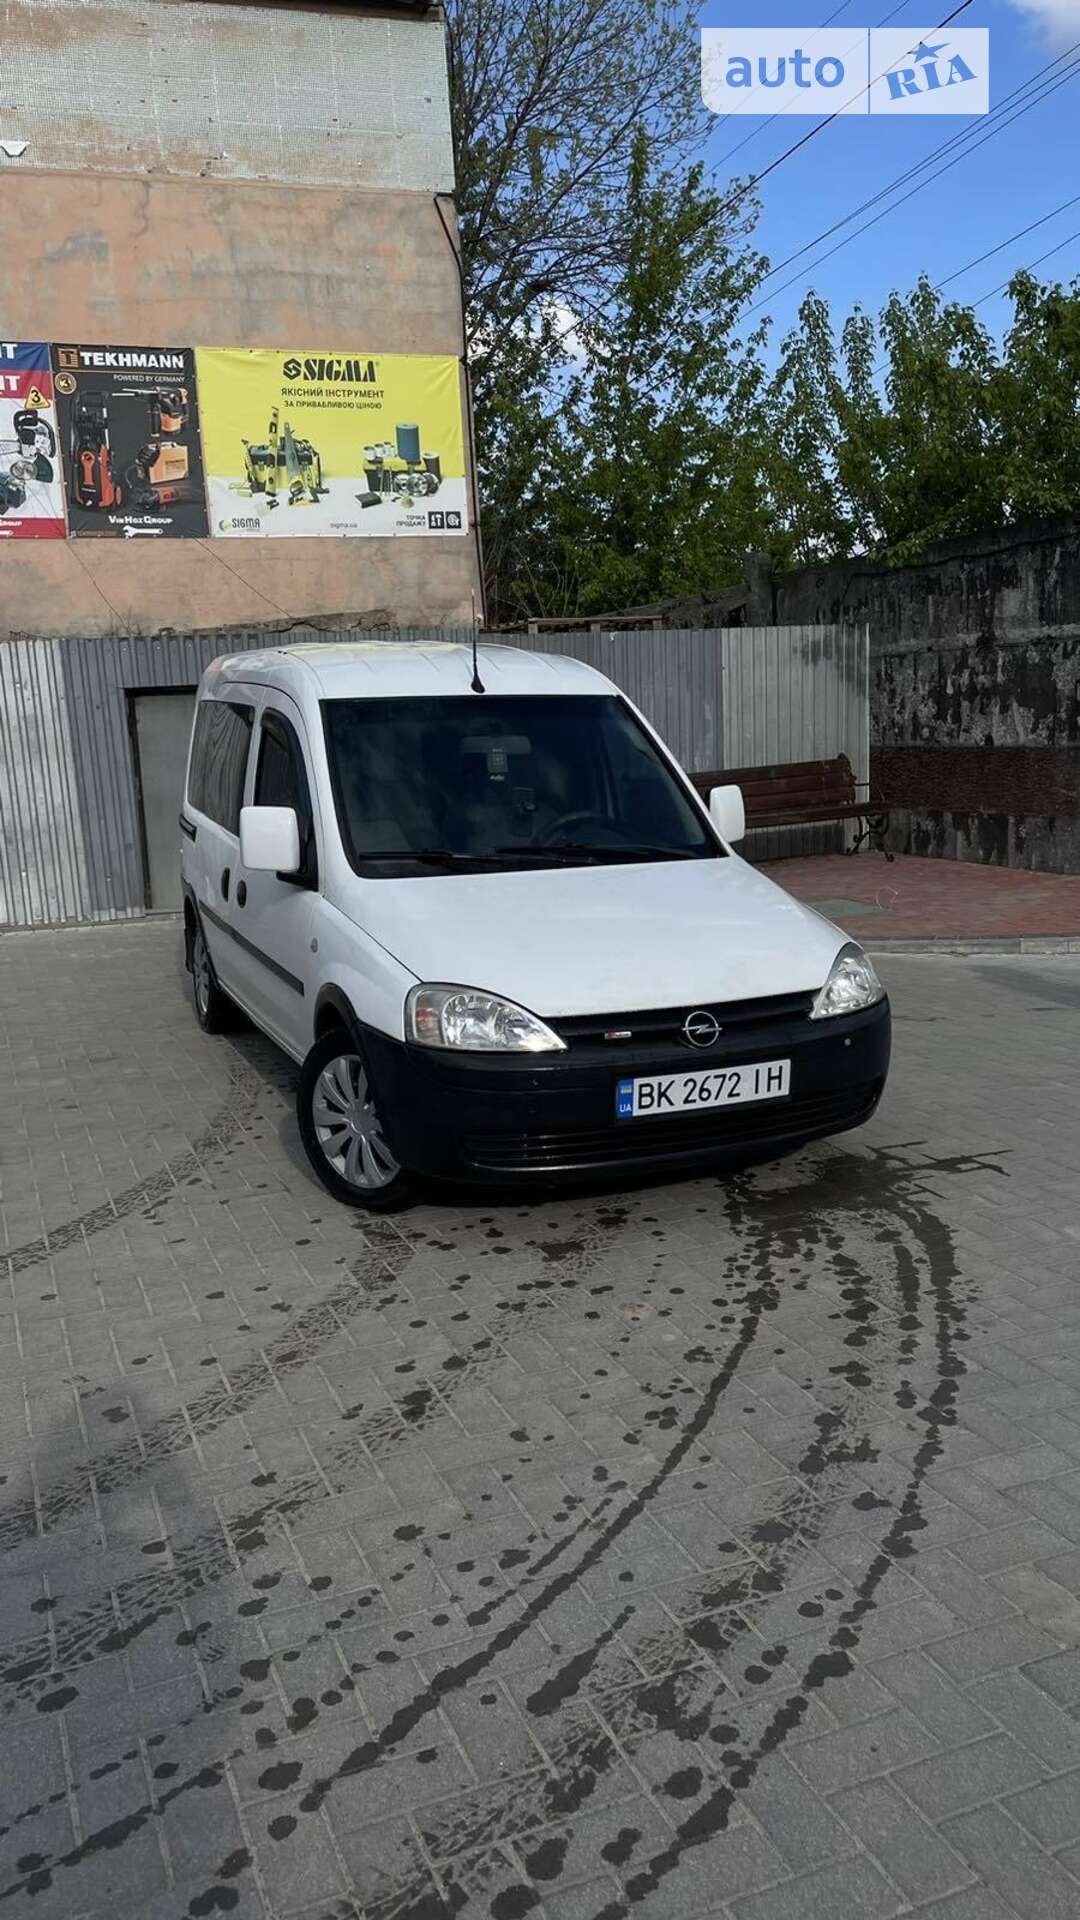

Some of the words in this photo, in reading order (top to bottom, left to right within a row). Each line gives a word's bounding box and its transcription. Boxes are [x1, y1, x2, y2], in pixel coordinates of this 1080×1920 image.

[80, 351, 184, 369] TEKHMANN
[303, 358, 376, 382] SIGMA
[113, 374, 145, 383] POWERED
[145, 375, 154, 383] BY
[154, 375, 185, 384] GERMANY
[31, 389, 41, 403] 3
[281, 386, 323, 397] ЯКІСНИЙ
[325, 388, 385, 398] ІНСТРУМЕНТ
[284, 400, 294, 408] ЗА
[296, 400, 355, 409] ПРИВАБЛИВОЮ
[356, 402, 383, 410] ЦІНОЮ
[231, 517, 260, 529] SIGMA
[637, 1079, 675, 1110] BK
[683, 1072, 742, 1105] 2672
[754, 1065, 784, 1095] IH
[619, 1103, 632, 1113] UA
